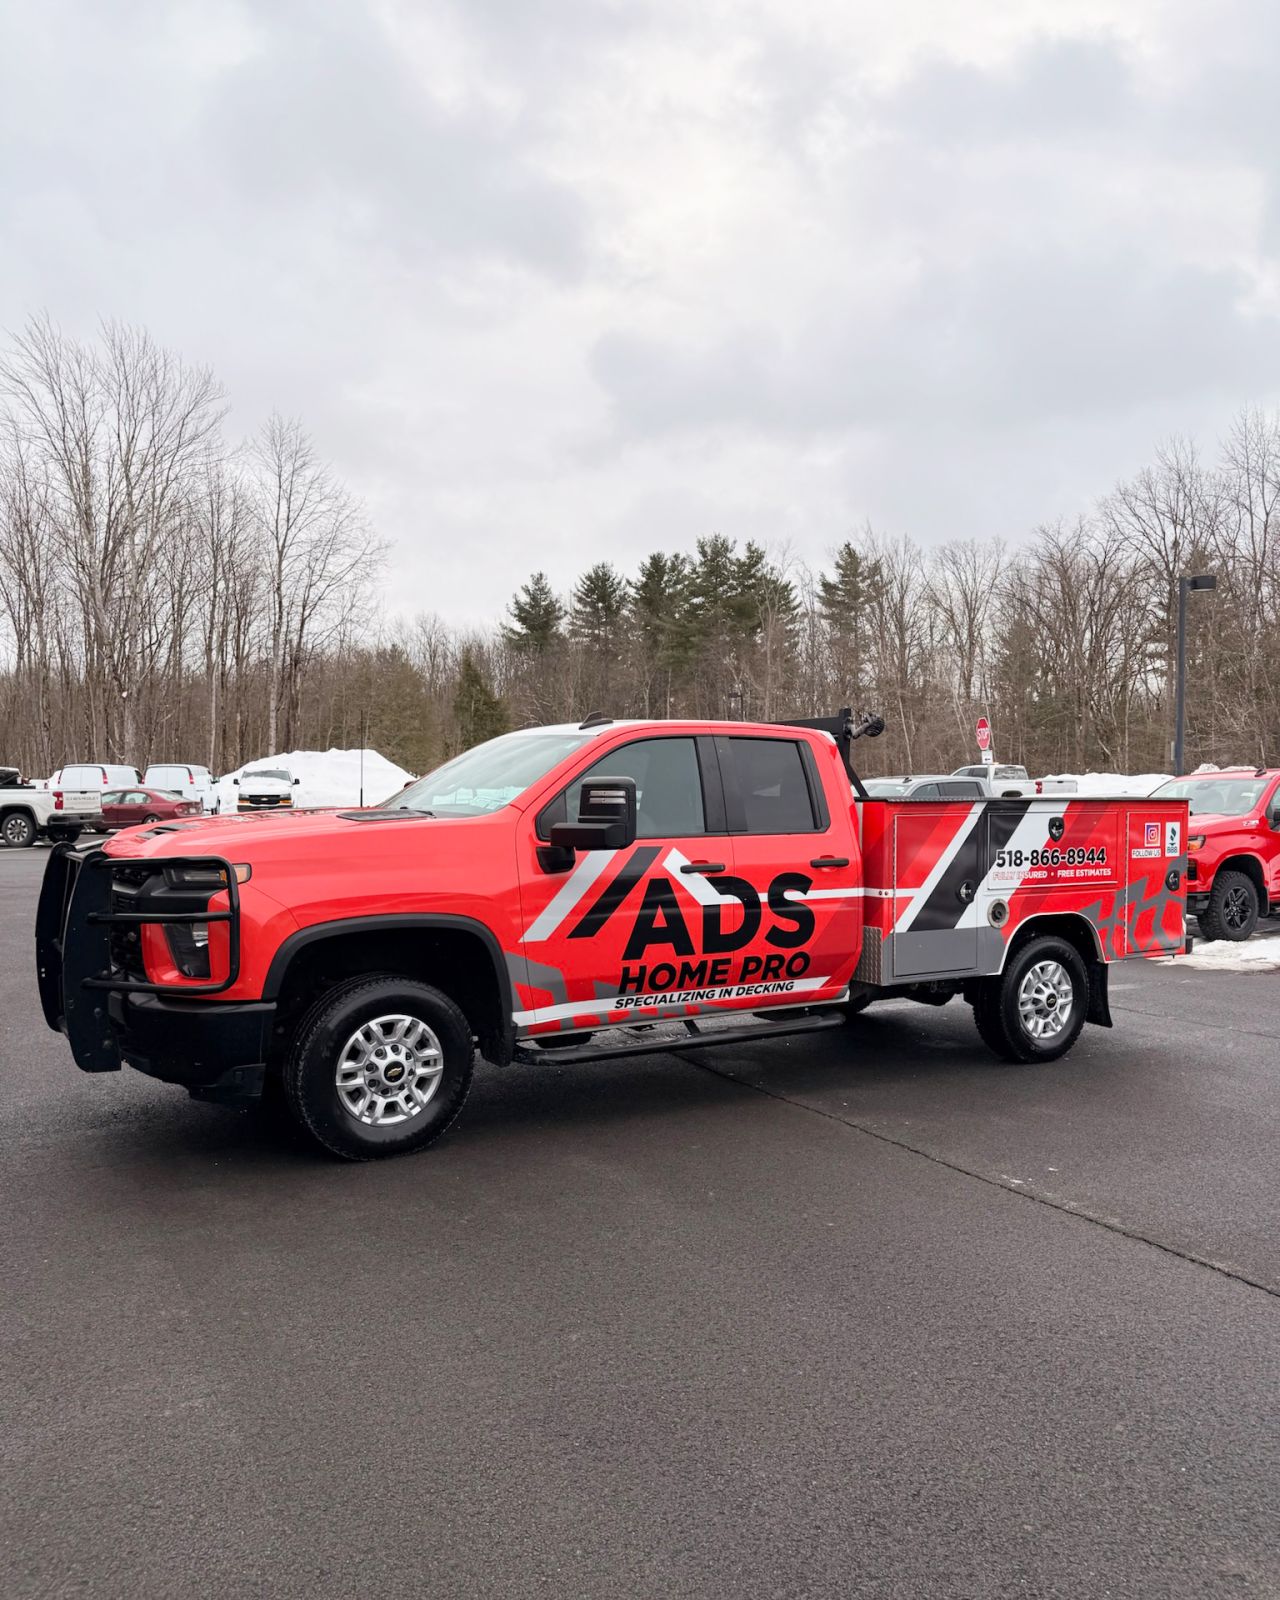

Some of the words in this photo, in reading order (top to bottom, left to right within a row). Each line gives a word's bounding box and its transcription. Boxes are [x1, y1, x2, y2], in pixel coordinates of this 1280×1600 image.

[976, 727, 991, 741] STOP
[995, 847, 1107, 868] 518-866-8944
[1154, 849, 1160, 857] US
[1017, 870, 1048, 880] INSURED
[1057, 869, 1075, 878] FREE
[1076, 868, 1112, 878] ESTIMATES
[621, 872, 816, 961] ADS
[618, 957, 732, 995] HOME
[739, 951, 811, 983] PRO
[614, 989, 716, 1009] SPECIALIZING
[718, 988, 733, 999] IN
[735, 981, 795, 997] DECKING
